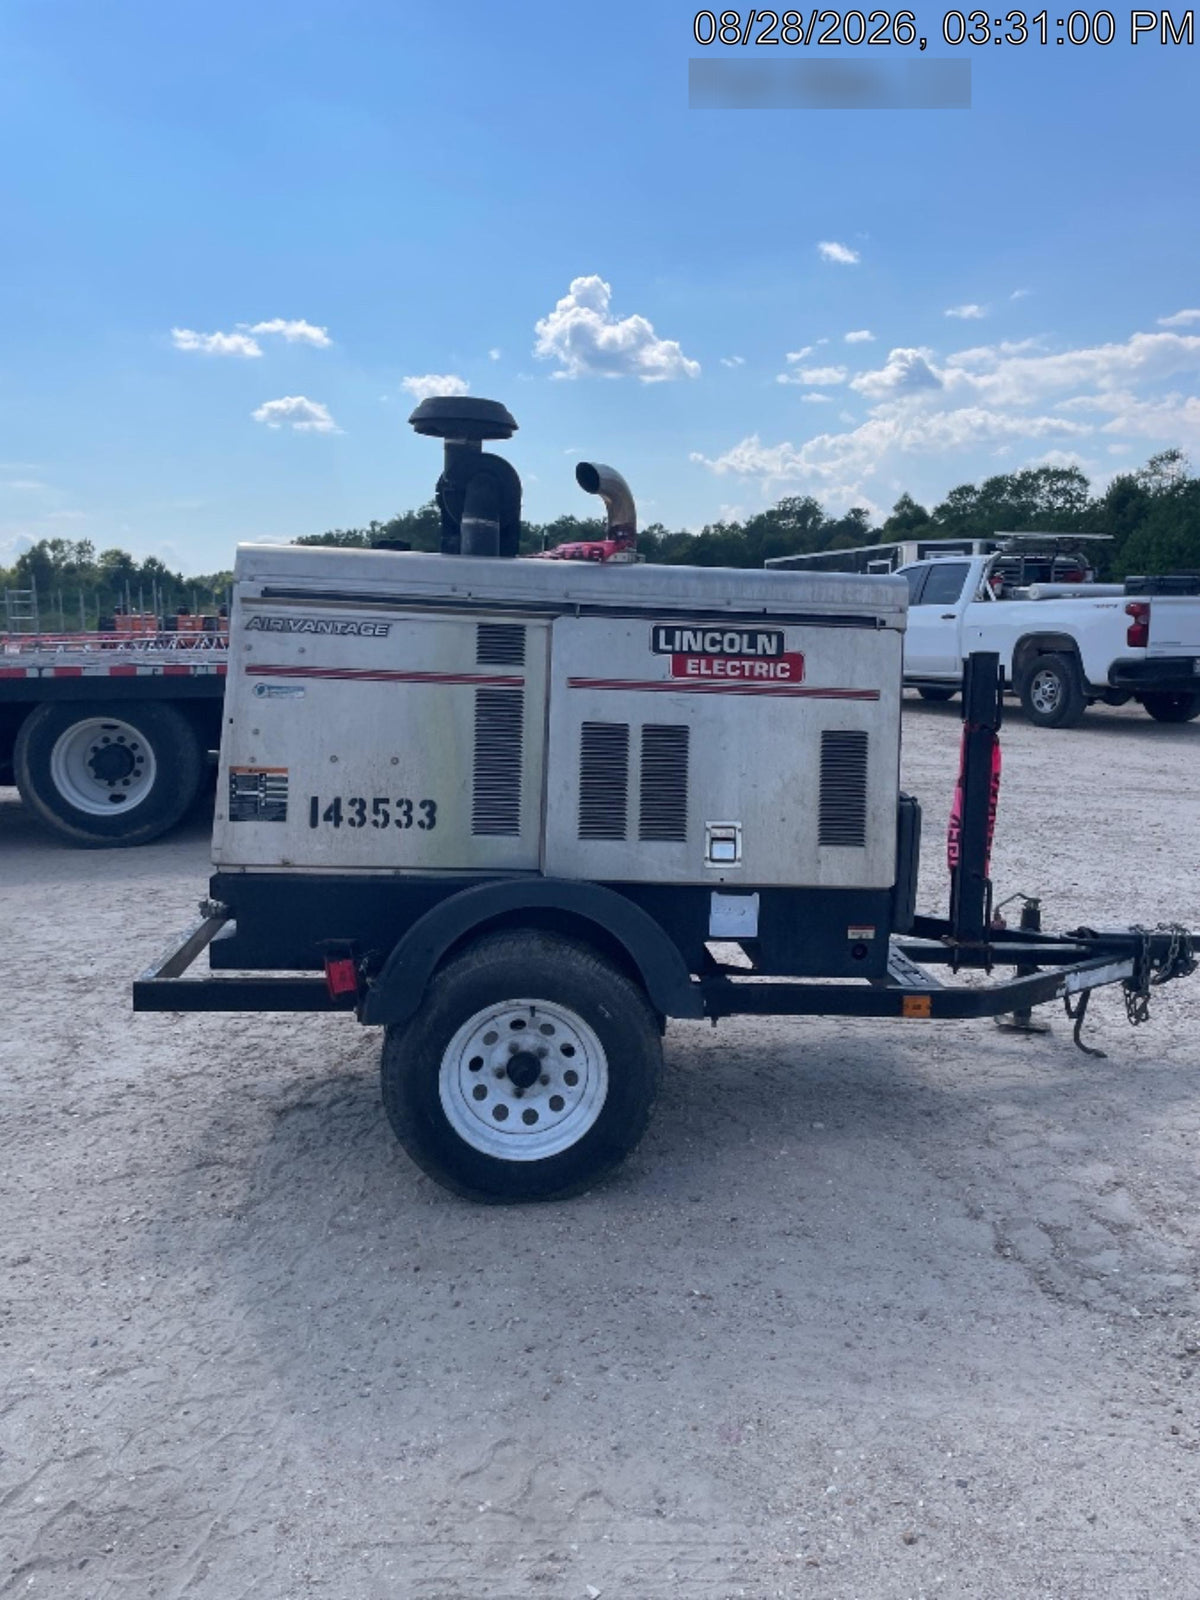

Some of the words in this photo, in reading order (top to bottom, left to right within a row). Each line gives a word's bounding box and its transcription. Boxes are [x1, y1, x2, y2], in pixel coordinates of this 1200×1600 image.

[658, 629, 778, 655] LINCOLN
[686, 659, 790, 678] ELECTRIC
[309, 796, 438, 830] 143533
